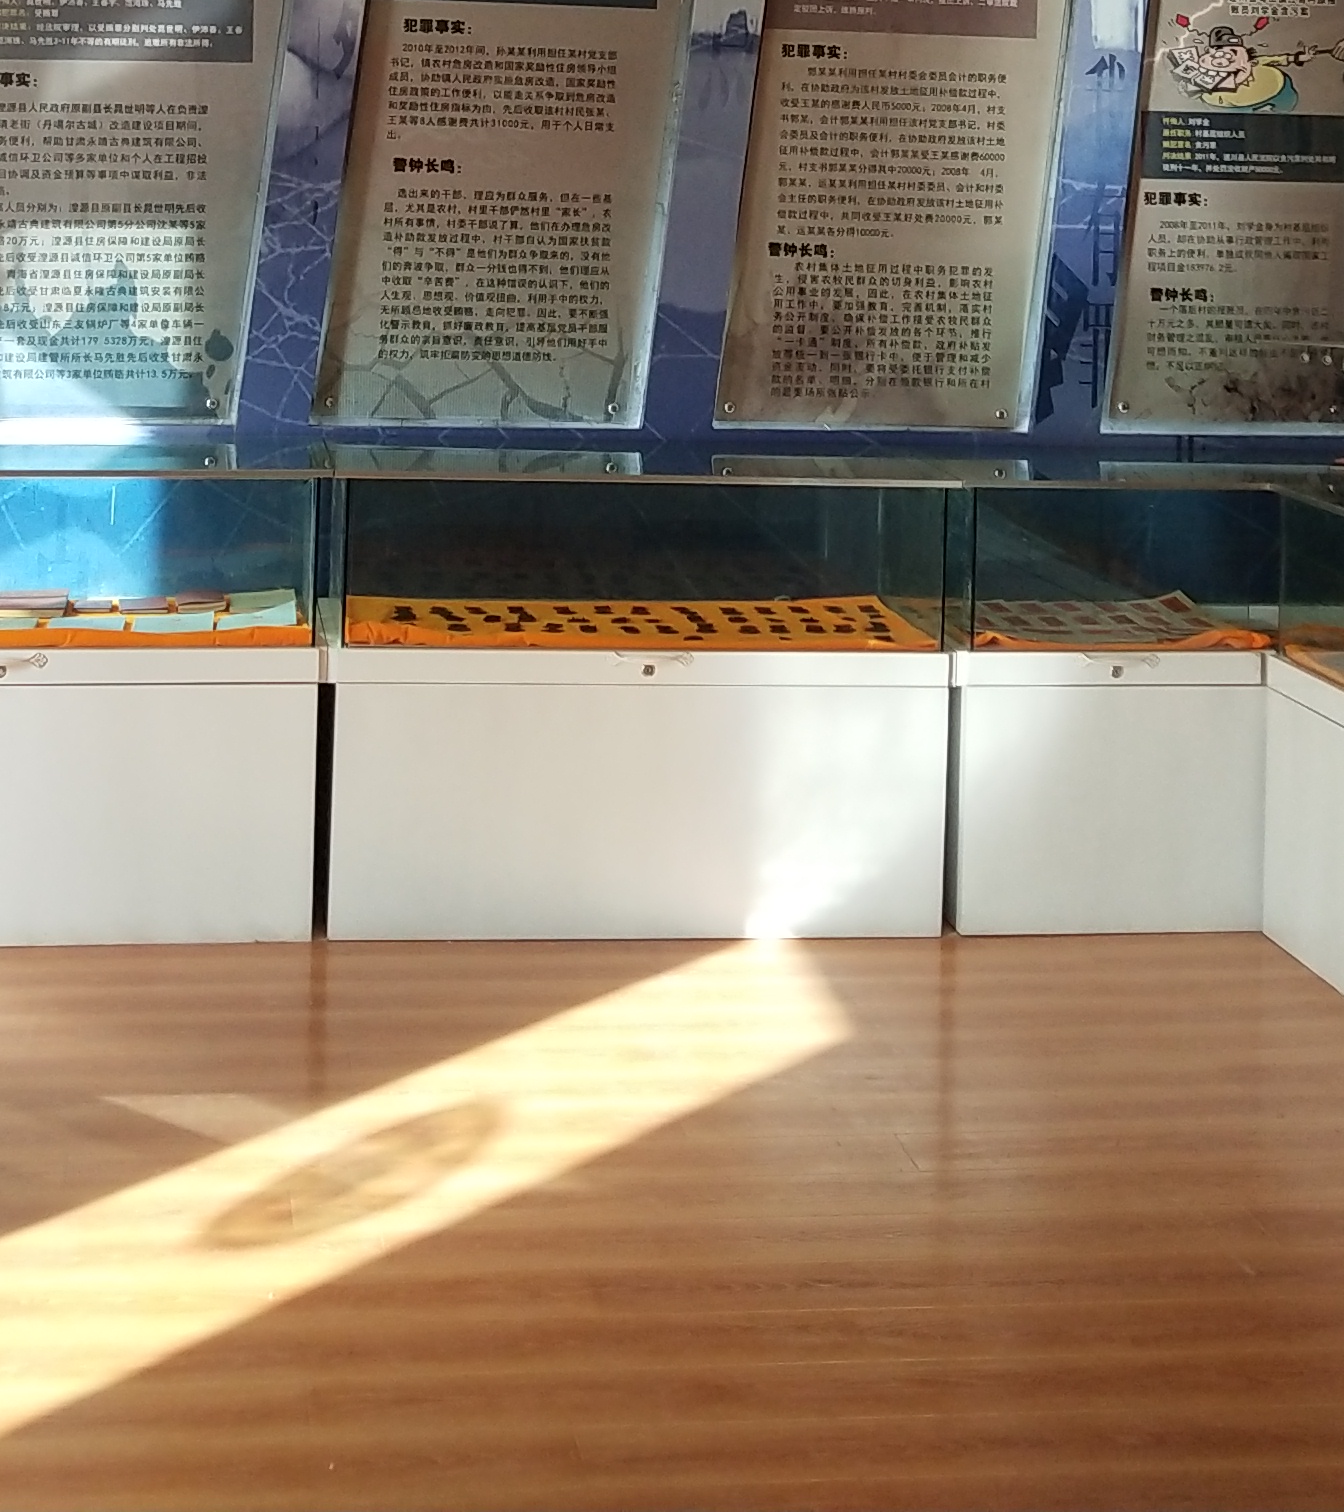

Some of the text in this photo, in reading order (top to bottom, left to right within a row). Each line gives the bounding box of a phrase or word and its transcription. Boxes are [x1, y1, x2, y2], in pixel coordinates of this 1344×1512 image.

[403, 18, 472, 35] 犯罪事实：
[782, 44, 848, 59] 犯罪事实：
[393, 158, 462, 175] 警钟长鸣：
[1144, 192, 1208, 207] 犯罪事实：
[768, 242, 836, 258] 警钟长鸣：
[1150, 287, 1215, 303] 警钟长鸣：
